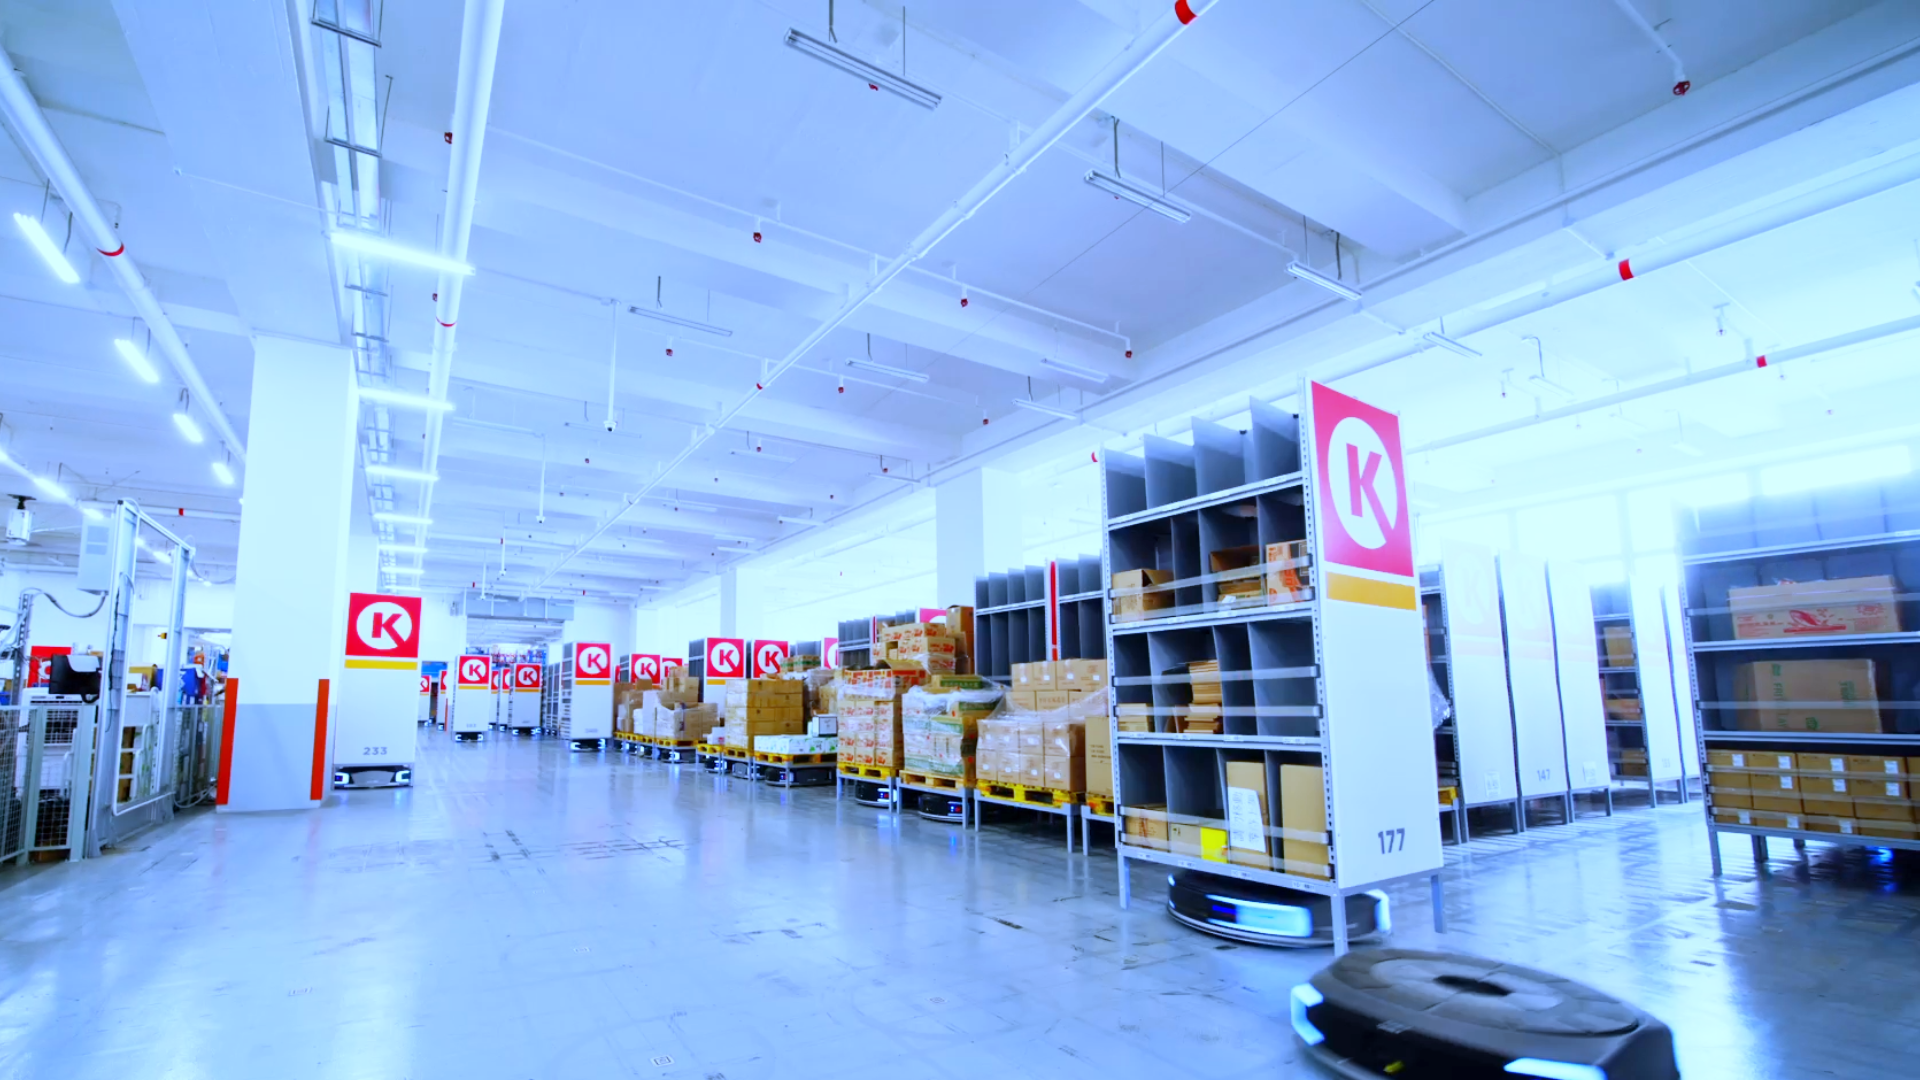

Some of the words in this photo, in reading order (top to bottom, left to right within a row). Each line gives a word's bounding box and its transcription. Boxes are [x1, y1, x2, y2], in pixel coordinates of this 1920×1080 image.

[1345, 442, 1392, 542] K
[371, 612, 406, 647] K
[587, 653, 604, 672] K
[719, 649, 737, 670] K
[765, 650, 781, 673] K
[468, 663, 483, 679] K
[523, 670, 535, 682] K
[640, 662, 655, 678] K
[363, 746, 387, 756] 233
[1537, 768, 1551, 781] 147
[1378, 827, 1405, 855] 177
